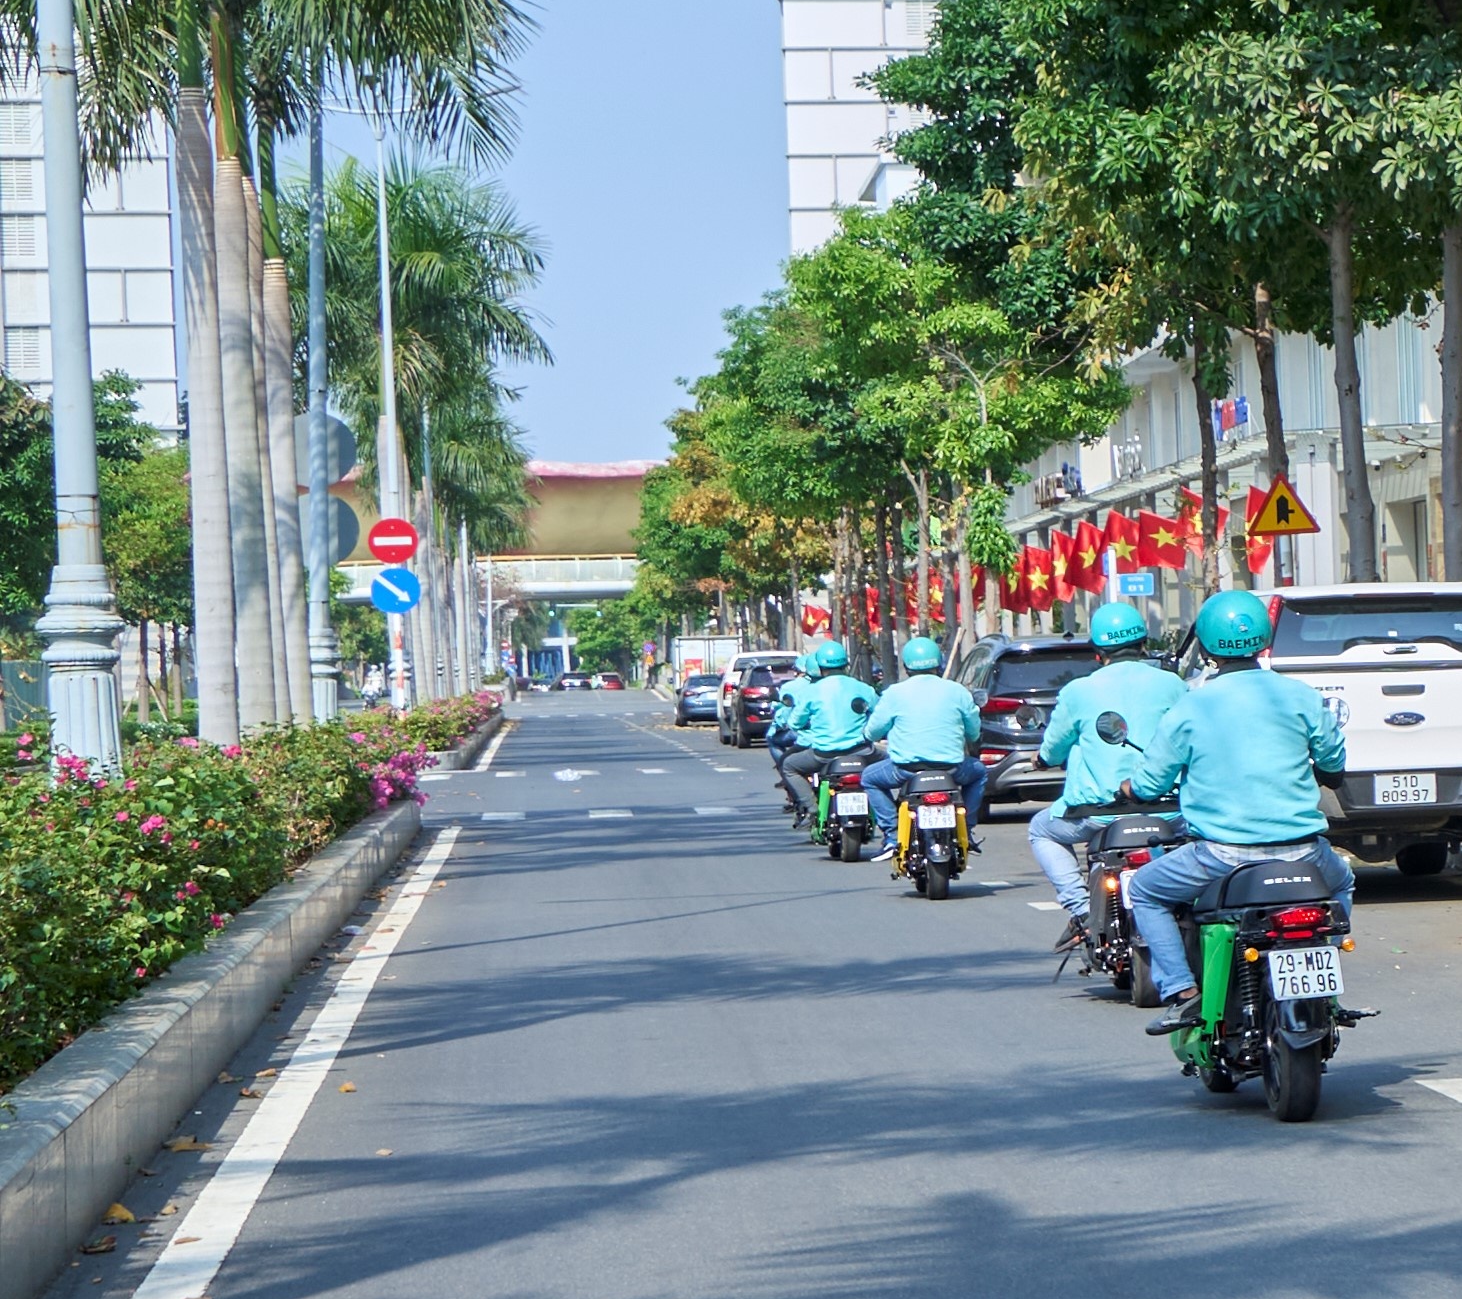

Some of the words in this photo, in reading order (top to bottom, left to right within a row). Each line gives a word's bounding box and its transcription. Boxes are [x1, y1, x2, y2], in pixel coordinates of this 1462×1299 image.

[1106, 625, 1142, 640] BAEMIN
[1218, 634, 1265, 649] BAEMIN
[1392, 775, 1419, 789] 51D
[1382, 789, 1430, 803] 809.97
[1279, 972, 1338, 997] 766.96
